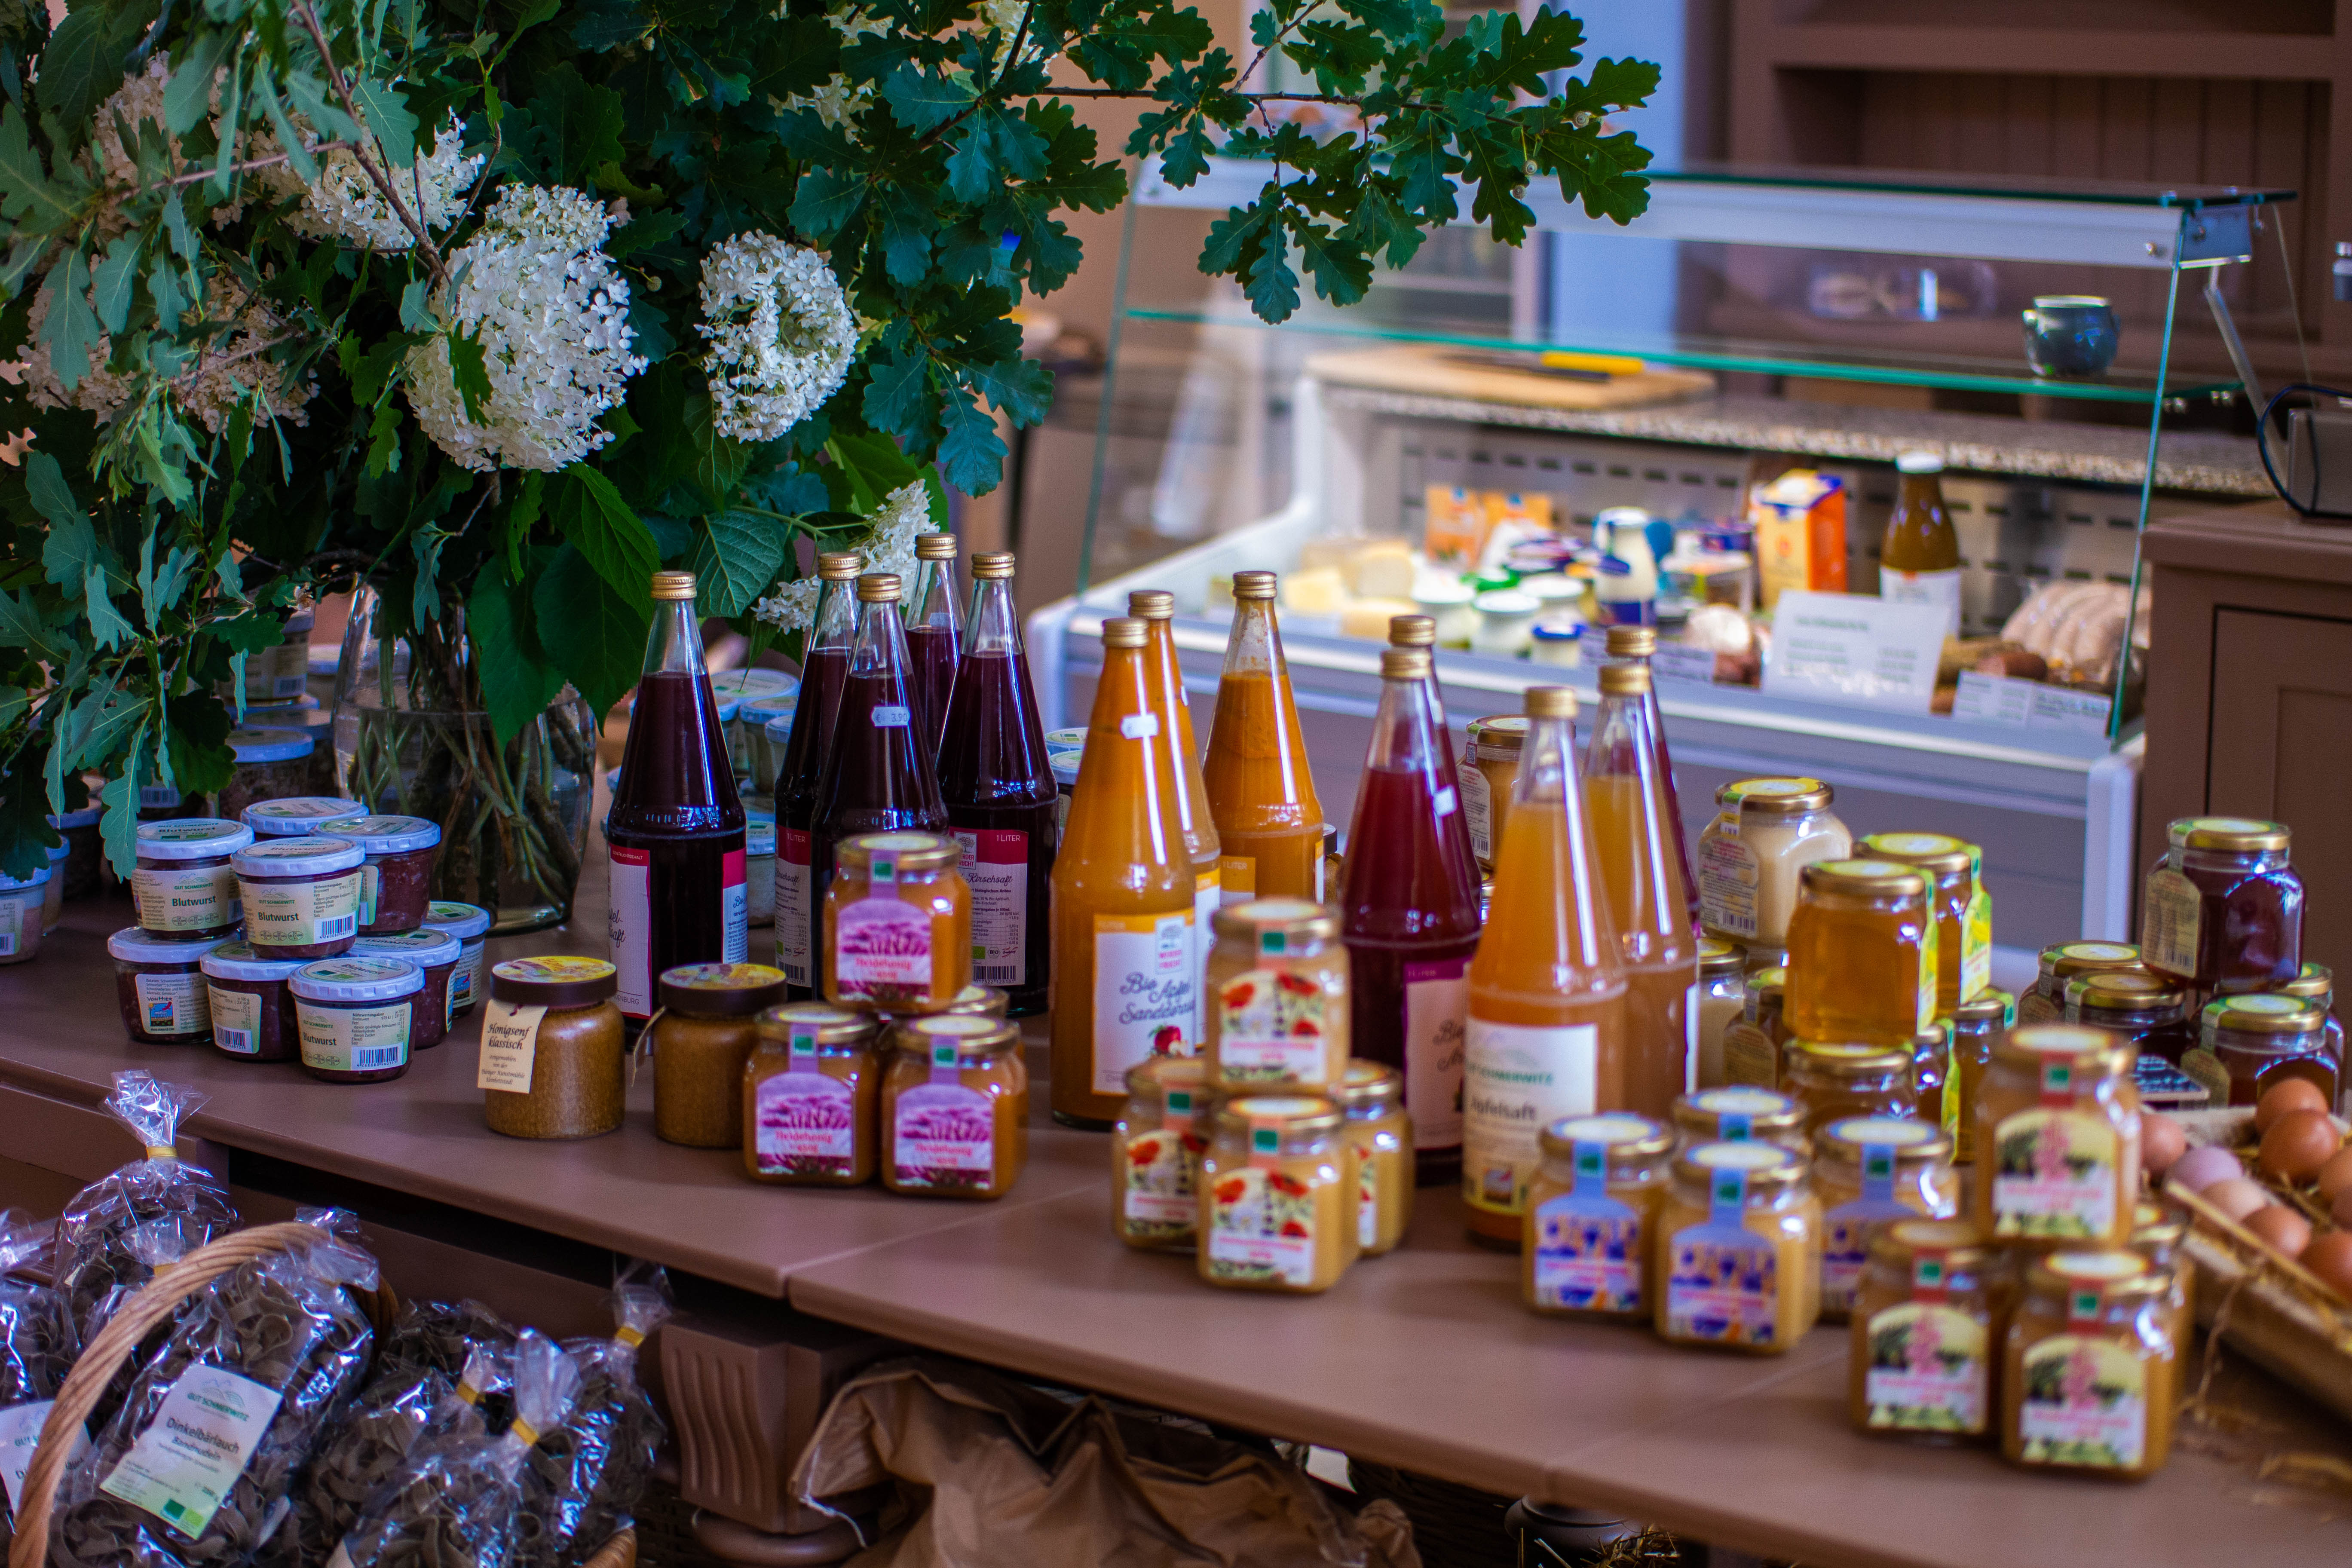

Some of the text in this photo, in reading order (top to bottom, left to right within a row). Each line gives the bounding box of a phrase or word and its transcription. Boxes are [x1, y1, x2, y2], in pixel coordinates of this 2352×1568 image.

[891, 713, 907, 722] 3.90
[966, 873, 1013, 887] Kirschsaft
[172, 895, 216, 907] Blutwurst
[258, 912, 300, 921] Blutwurst
[1119, 971, 1157, 995] Bio
[487, 1023, 532, 1039] Honigsenf
[303, 1032, 337, 1046] Blutwurst
[488, 1036, 523, 1050] klassisch
[166, 1417, 240, 1454] Dinkelbärlauch
